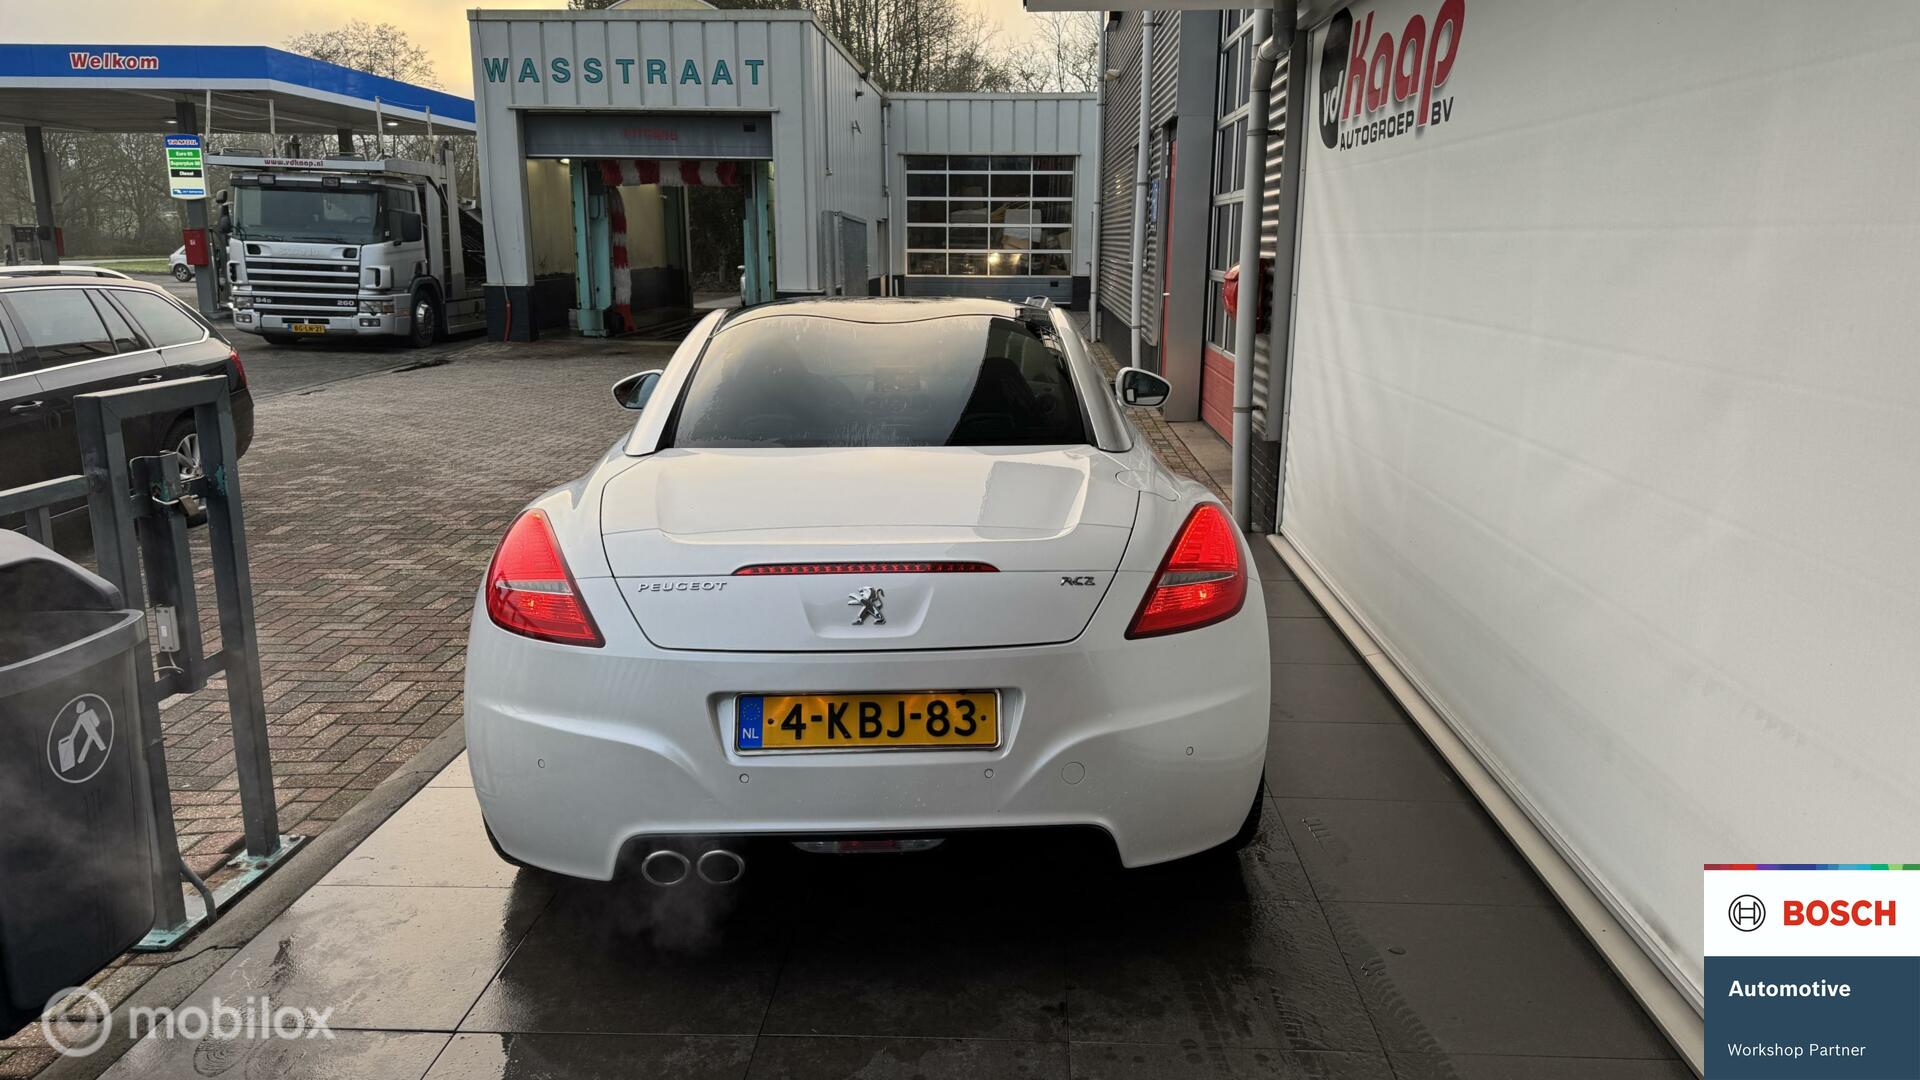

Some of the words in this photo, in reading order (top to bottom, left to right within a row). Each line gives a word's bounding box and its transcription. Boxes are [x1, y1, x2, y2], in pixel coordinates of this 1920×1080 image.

[69, 52, 159, 70] Welkom
[1340, 0, 1465, 127] Kaap
[484, 57, 764, 85] WASSTRAAT
[1340, 110, 1414, 151] AUTOGROEP
[1431, 97, 1454, 126] BV
[264, 159, 323, 167] www.vdkaap.nl
[638, 582, 728, 592] PEUGEOT
[1060, 576, 1096, 586] RCZ
[780, 699, 977, 740] 4-KBJ-83
[742, 728, 759, 739] NL
